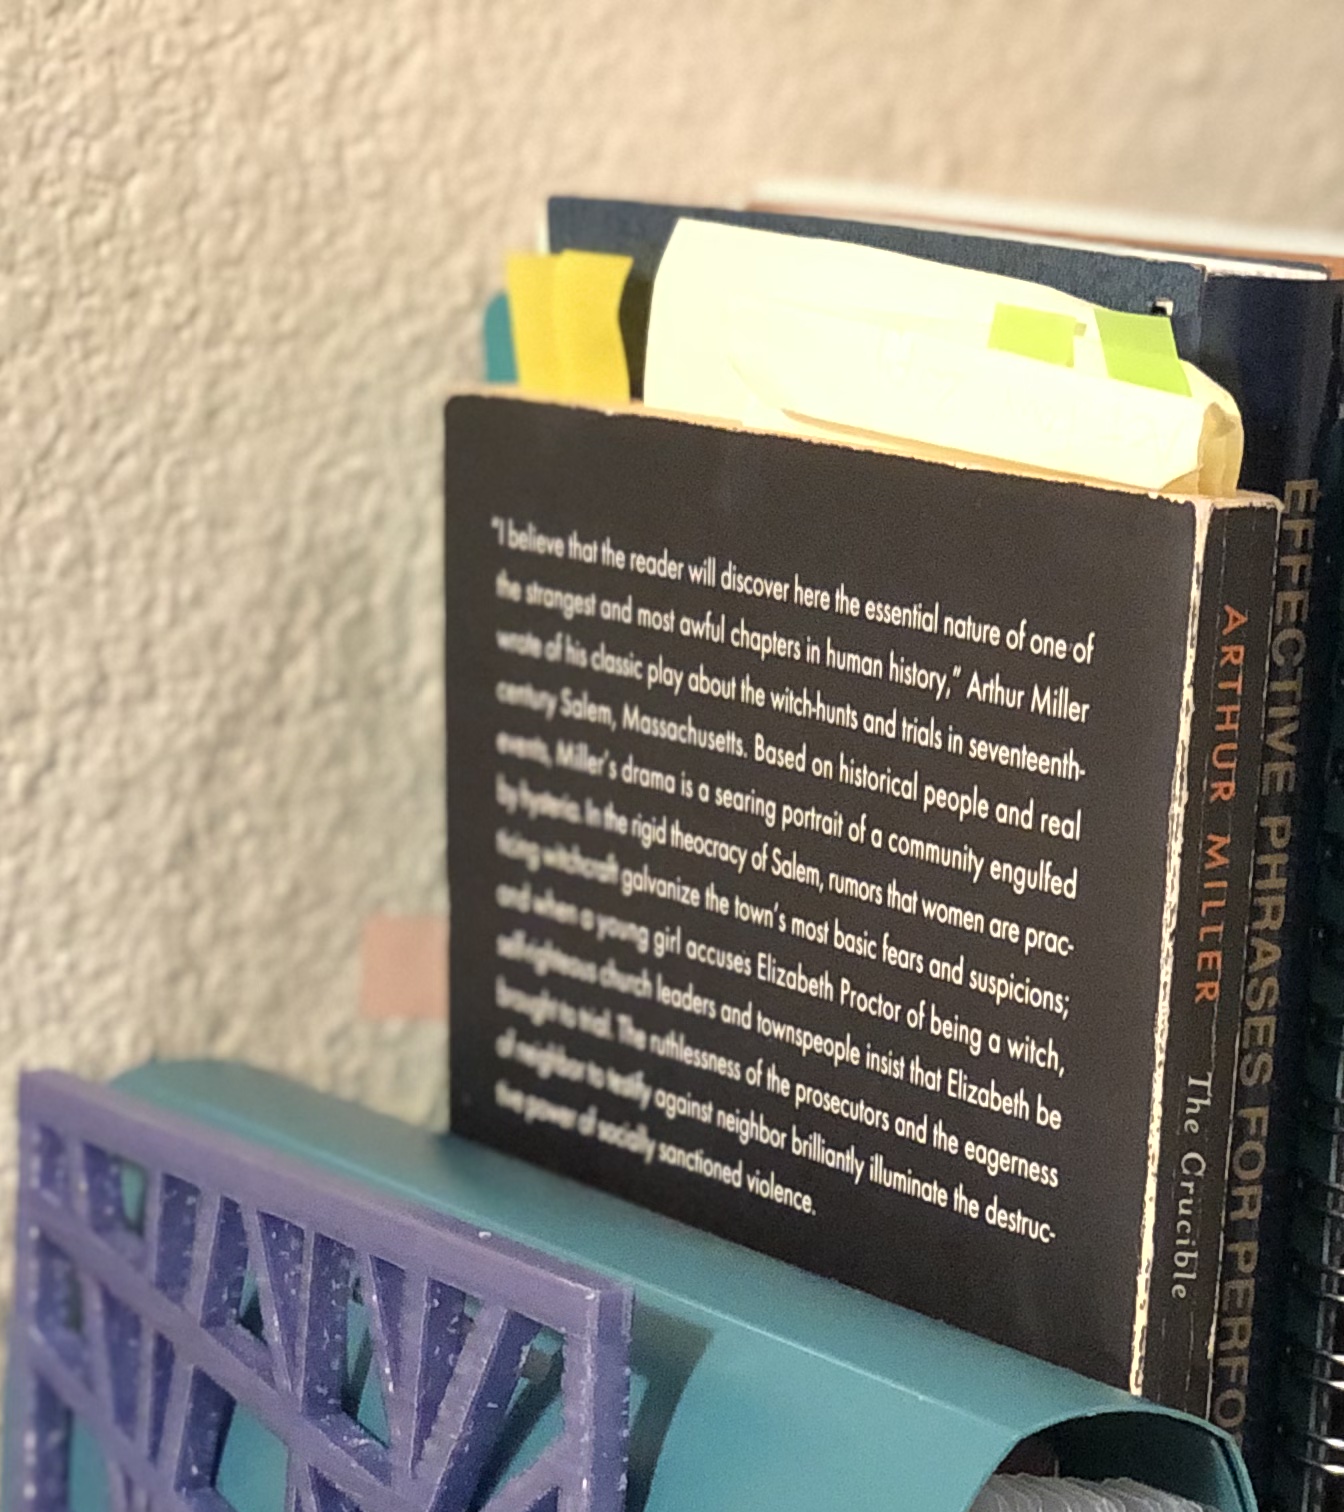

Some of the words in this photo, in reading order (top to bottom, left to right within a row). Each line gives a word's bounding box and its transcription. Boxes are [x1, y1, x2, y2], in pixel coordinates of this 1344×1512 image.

[506, 518, 565, 558] believe
[567, 530, 598, 563] that
[600, 536, 625, 569] the
[629, 547, 684, 580] reader
[687, 556, 716, 587] will
[720, 560, 790, 602] discover
[793, 572, 830, 611] here
[834, 582, 860, 617] the
[864, 599, 939, 633] essential
[942, 614, 1001, 646] nature
[1005, 617, 1027, 651] of
[1029, 633, 1067, 659] one
[1072, 631, 1095, 664] of
[525, 580, 597, 620] strangest
[599, 594, 632, 624] and
[636, 607, 675, 632] most
[679, 609, 725, 643] awful
[729, 616, 801, 661] chapters
[805, 635, 820, 664] in
[825, 635, 883, 679] human
[965, 670, 1025, 709] Arthur
[1030, 682, 1090, 723] Miller
[1262, 479, 1319, 797] EFFECTIVE
[559, 686, 616, 731] Salem,
[621, 702, 747, 758] Massachusetts.
[753, 732, 806, 772] Based
[811, 756, 833, 779] on
[838, 751, 918, 801] historical
[922, 784, 989, 822] people
[994, 797, 1034, 830] and
[1039, 808, 1081, 840] real
[589, 641, 643, 680] classic
[646, 654, 684, 696] play
[687, 662, 736, 700] about
[739, 672, 765, 707] the
[769, 686, 858, 730] witch-hunts
[862, 707, 897, 738] and
[901, 715, 942, 750] trials
[947, 724, 963, 755] in
[968, 737, 1085, 781] seventeenth-
[1210, 604, 1249, 802] ARTHUR
[555, 739, 618, 780] Miller's
[620, 753, 676, 794] drama
[680, 771, 694, 799] is
[697, 782, 710, 802] a
[714, 786, 776, 828] searing
[781, 803, 843, 837] portrait
[847, 812, 867, 843] of
[870, 827, 882, 848] a
[887, 832, 985, 883] community
[989, 858, 1078, 899] engulfed
[630, 815, 667, 849] rigid
[669, 818, 748, 874] theocracy
[750, 841, 768, 871] of
[770, 846, 824, 893] Salem,
[828, 872, 883, 905] rumors
[886, 877, 918, 914] that
[920, 898, 984, 933] women
[988, 917, 1020, 943] are
[1023, 926, 1074, 956] prac-
[620, 863, 701, 907] galvanize
[704, 881, 730, 915] the
[733, 894, 786, 932] town's
[790, 916, 829, 944] most
[833, 917, 877, 959] basic
[881, 931, 924, 973] fears
[928, 954, 964, 985] and
[968, 968, 1069, 1020] suspicions;
[1194, 832, 1231, 1004] MILLER
[1239, 815, 1293, 1087] PHRASES
[652, 925, 681, 958] girl
[685, 939, 752, 976] accuses
[756, 951, 834, 1002] Elizabeth
[839, 976, 902, 1022] Proctor
[905, 998, 926, 1030] of
[929, 1002, 982, 1056] being
[987, 1032, 1001, 1054] a
[1006, 1034, 1064, 1078] witch,
[655, 973, 716, 1019] leaders
[719, 1000, 752, 1030] and
[756, 1009, 860, 1067] townspeople
[865, 1042, 905, 1080] insist
[909, 1054, 942, 1092] that
[946, 1067, 1030, 1120] Elizabeth
[1035, 1092, 1062, 1130] be
[649, 1030, 741, 1081] ruthlessness
[744, 1057, 763, 1087] of
[765, 1062, 791, 1097] the
[794, 1082, 890, 1131] prosecutors
[894, 1113, 927, 1144] and
[932, 1118, 959, 1155] the
[963, 1139, 1058, 1187] eagerness
[653, 1088, 714, 1123] against
[716, 1108, 787, 1149] neighbor
[790, 1123, 865, 1185] brilliantly
[868, 1152, 948, 1207] illuminate
[952, 1182, 980, 1219] the
[984, 1194, 1056, 1243] destruc-
[657, 1141, 743, 1188] sanctioned
[745, 1169, 816, 1215] violence.
[1182, 1071, 1213, 1134] The
[1230, 1106, 1269, 1220] FOR
[1171, 1150, 1207, 1299] Crucible
[1213, 1240, 1258, 1443] PERFO
